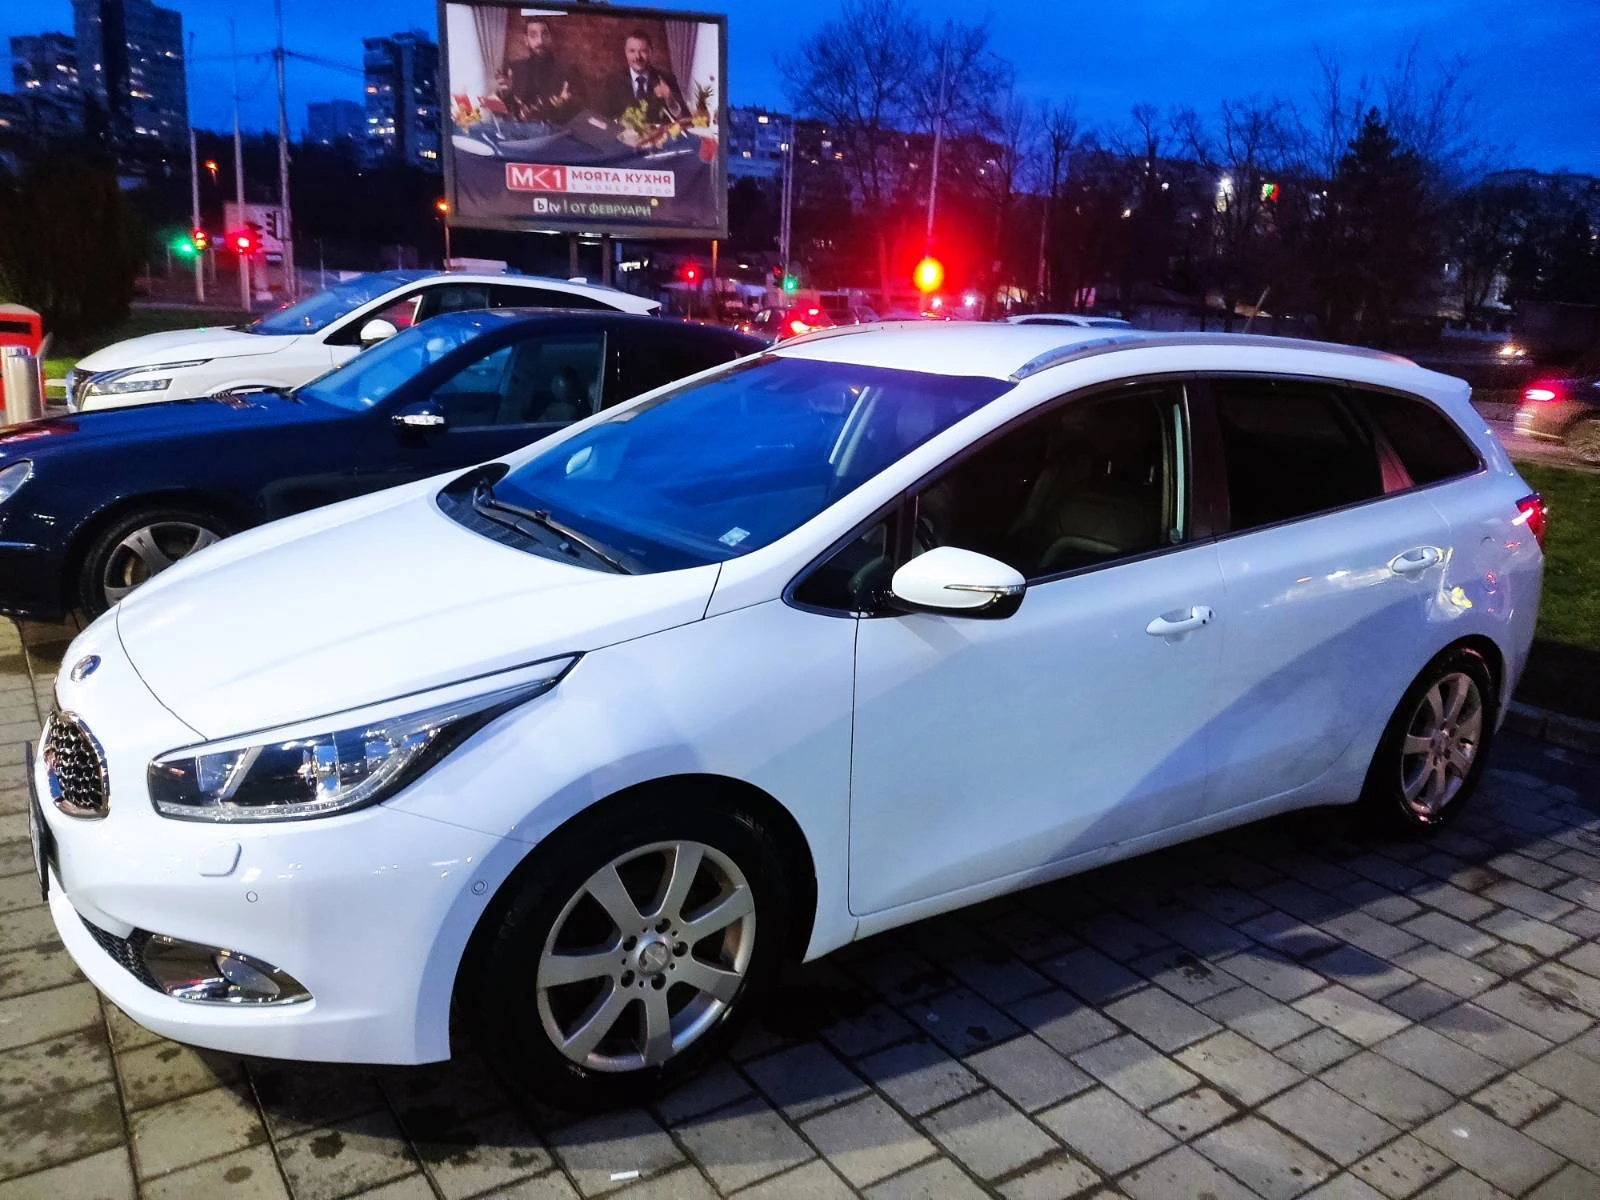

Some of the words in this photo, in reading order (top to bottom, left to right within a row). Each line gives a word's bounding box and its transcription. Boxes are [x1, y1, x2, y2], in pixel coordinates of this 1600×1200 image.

[571, 170, 620, 183] МОЯТА
[625, 172, 671, 185] КУХНЯ
[570, 202, 586, 214] ОТ
[588, 202, 651, 216] ФЕВРУАРИ
